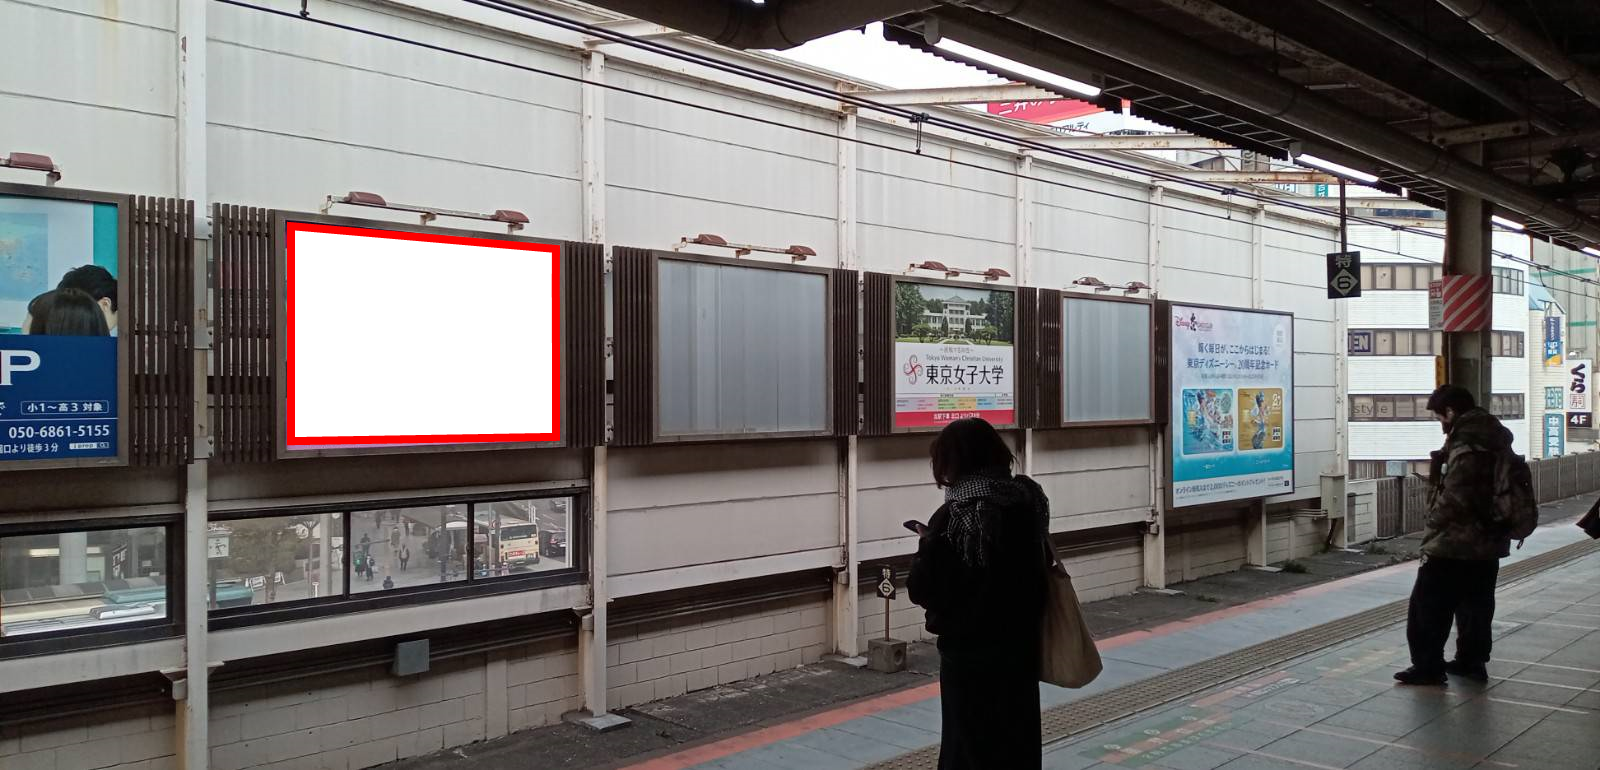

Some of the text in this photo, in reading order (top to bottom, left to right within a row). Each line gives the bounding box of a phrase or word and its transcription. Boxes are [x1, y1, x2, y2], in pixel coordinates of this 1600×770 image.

[1335, 254, 1353, 268] 特
[1337, 275, 1351, 289] 6
[0, 350, 41, 386] P
[925, 364, 1004, 385] 東京女子大学
[82, 402, 103, 412] 対象
[1570, 415, 1587, 424] 4F
[8, 424, 110, 439] 050-6861-5155
[882, 582, 891, 593] 6
